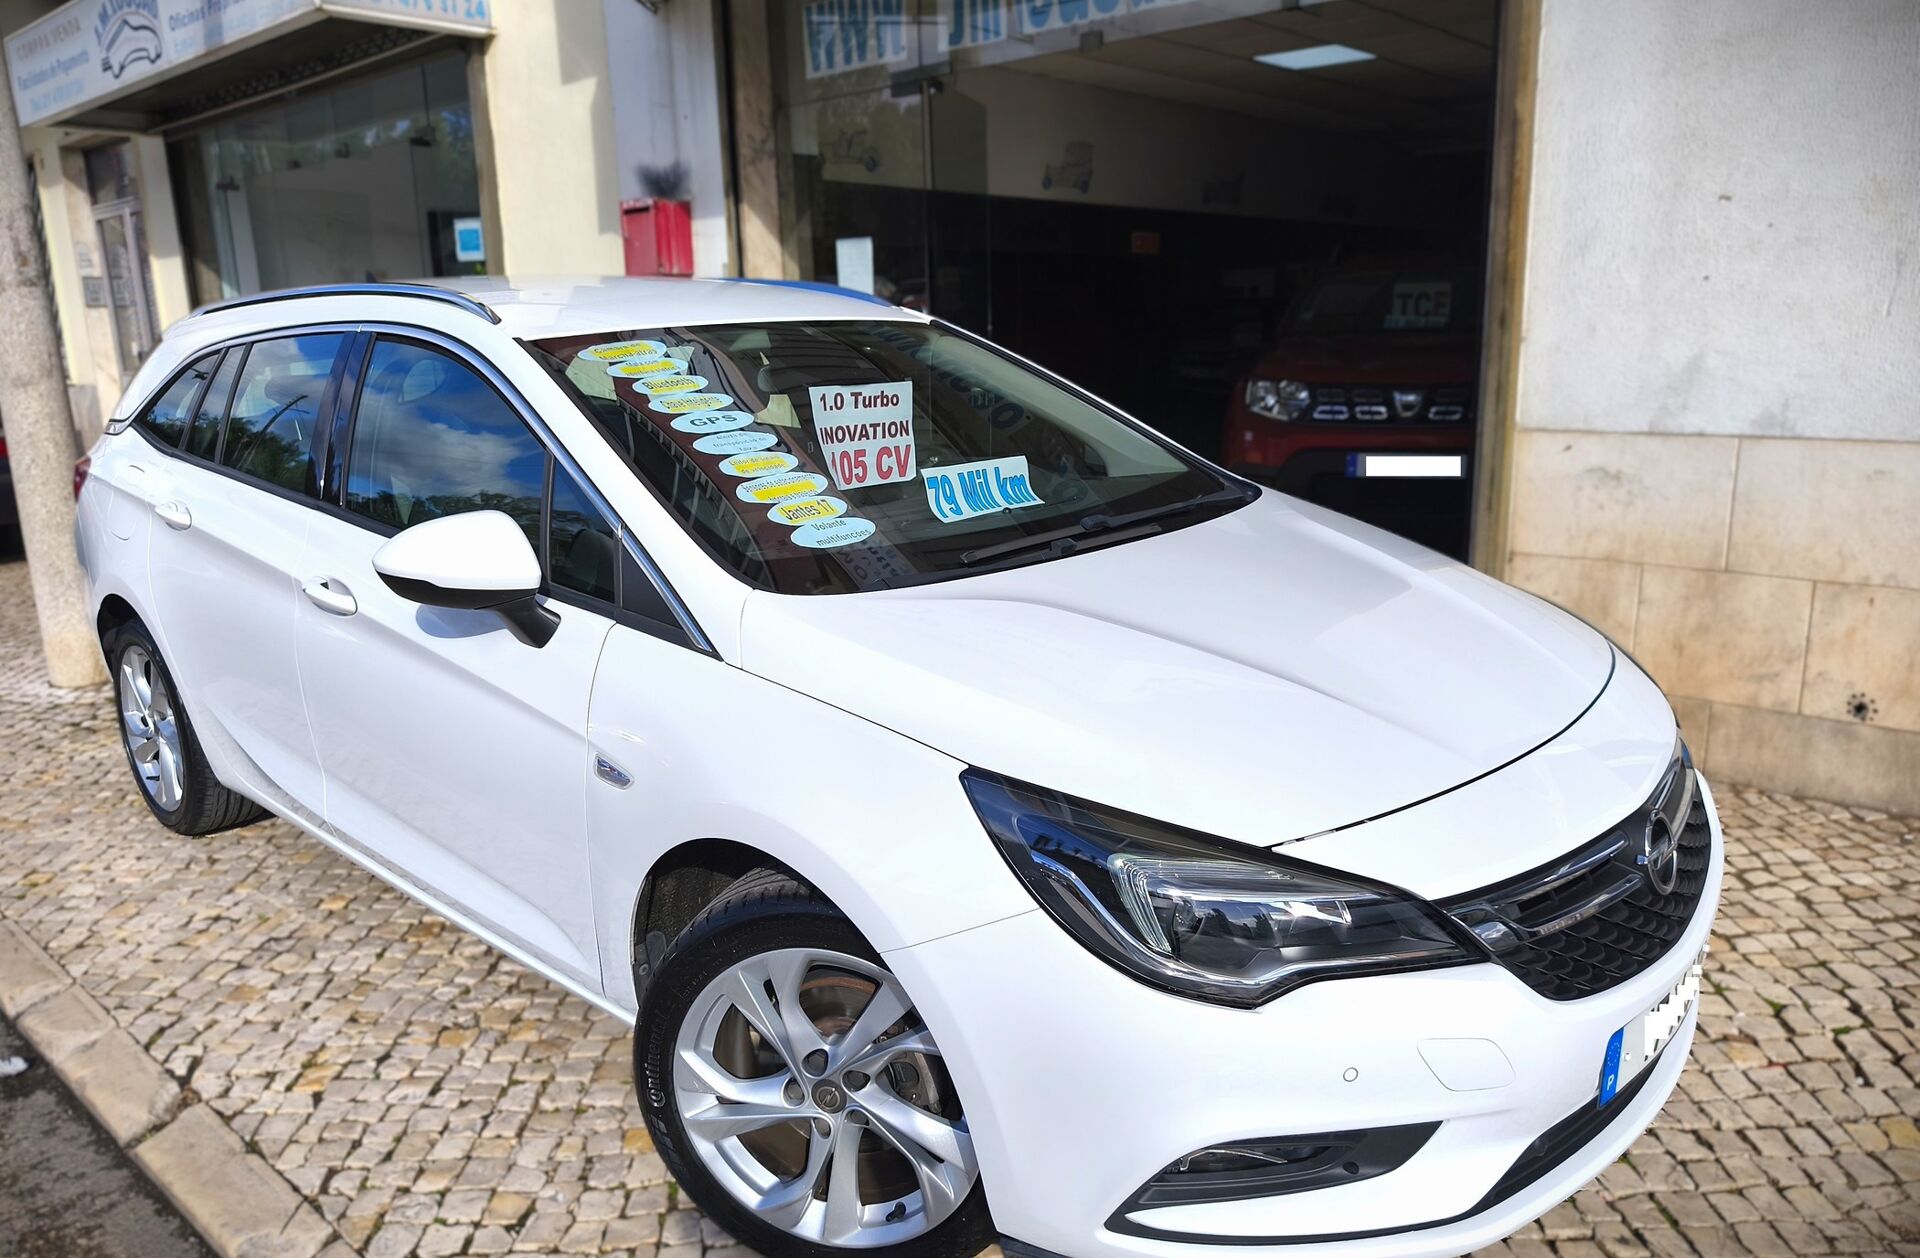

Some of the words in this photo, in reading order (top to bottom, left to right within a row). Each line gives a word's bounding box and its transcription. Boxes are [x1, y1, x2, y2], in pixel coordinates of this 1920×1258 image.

[1397, 289, 1450, 316] TCE
[642, 378, 695, 390] Bluetooth
[820, 392, 845, 411] 1.0
[850, 390, 900, 409] Turbo
[690, 414, 738, 427] GPS
[820, 420, 910, 445] INOVATION
[876, 444, 911, 480] CV
[926, 474, 963, 518] 79
[957, 468, 1002, 512] Mil
[994, 466, 1037, 505] km
[781, 502, 819, 521] Jantes
[816, 499, 834, 513] 17
[811, 519, 847, 531] Volante
[1606, 1074, 1615, 1091] P
